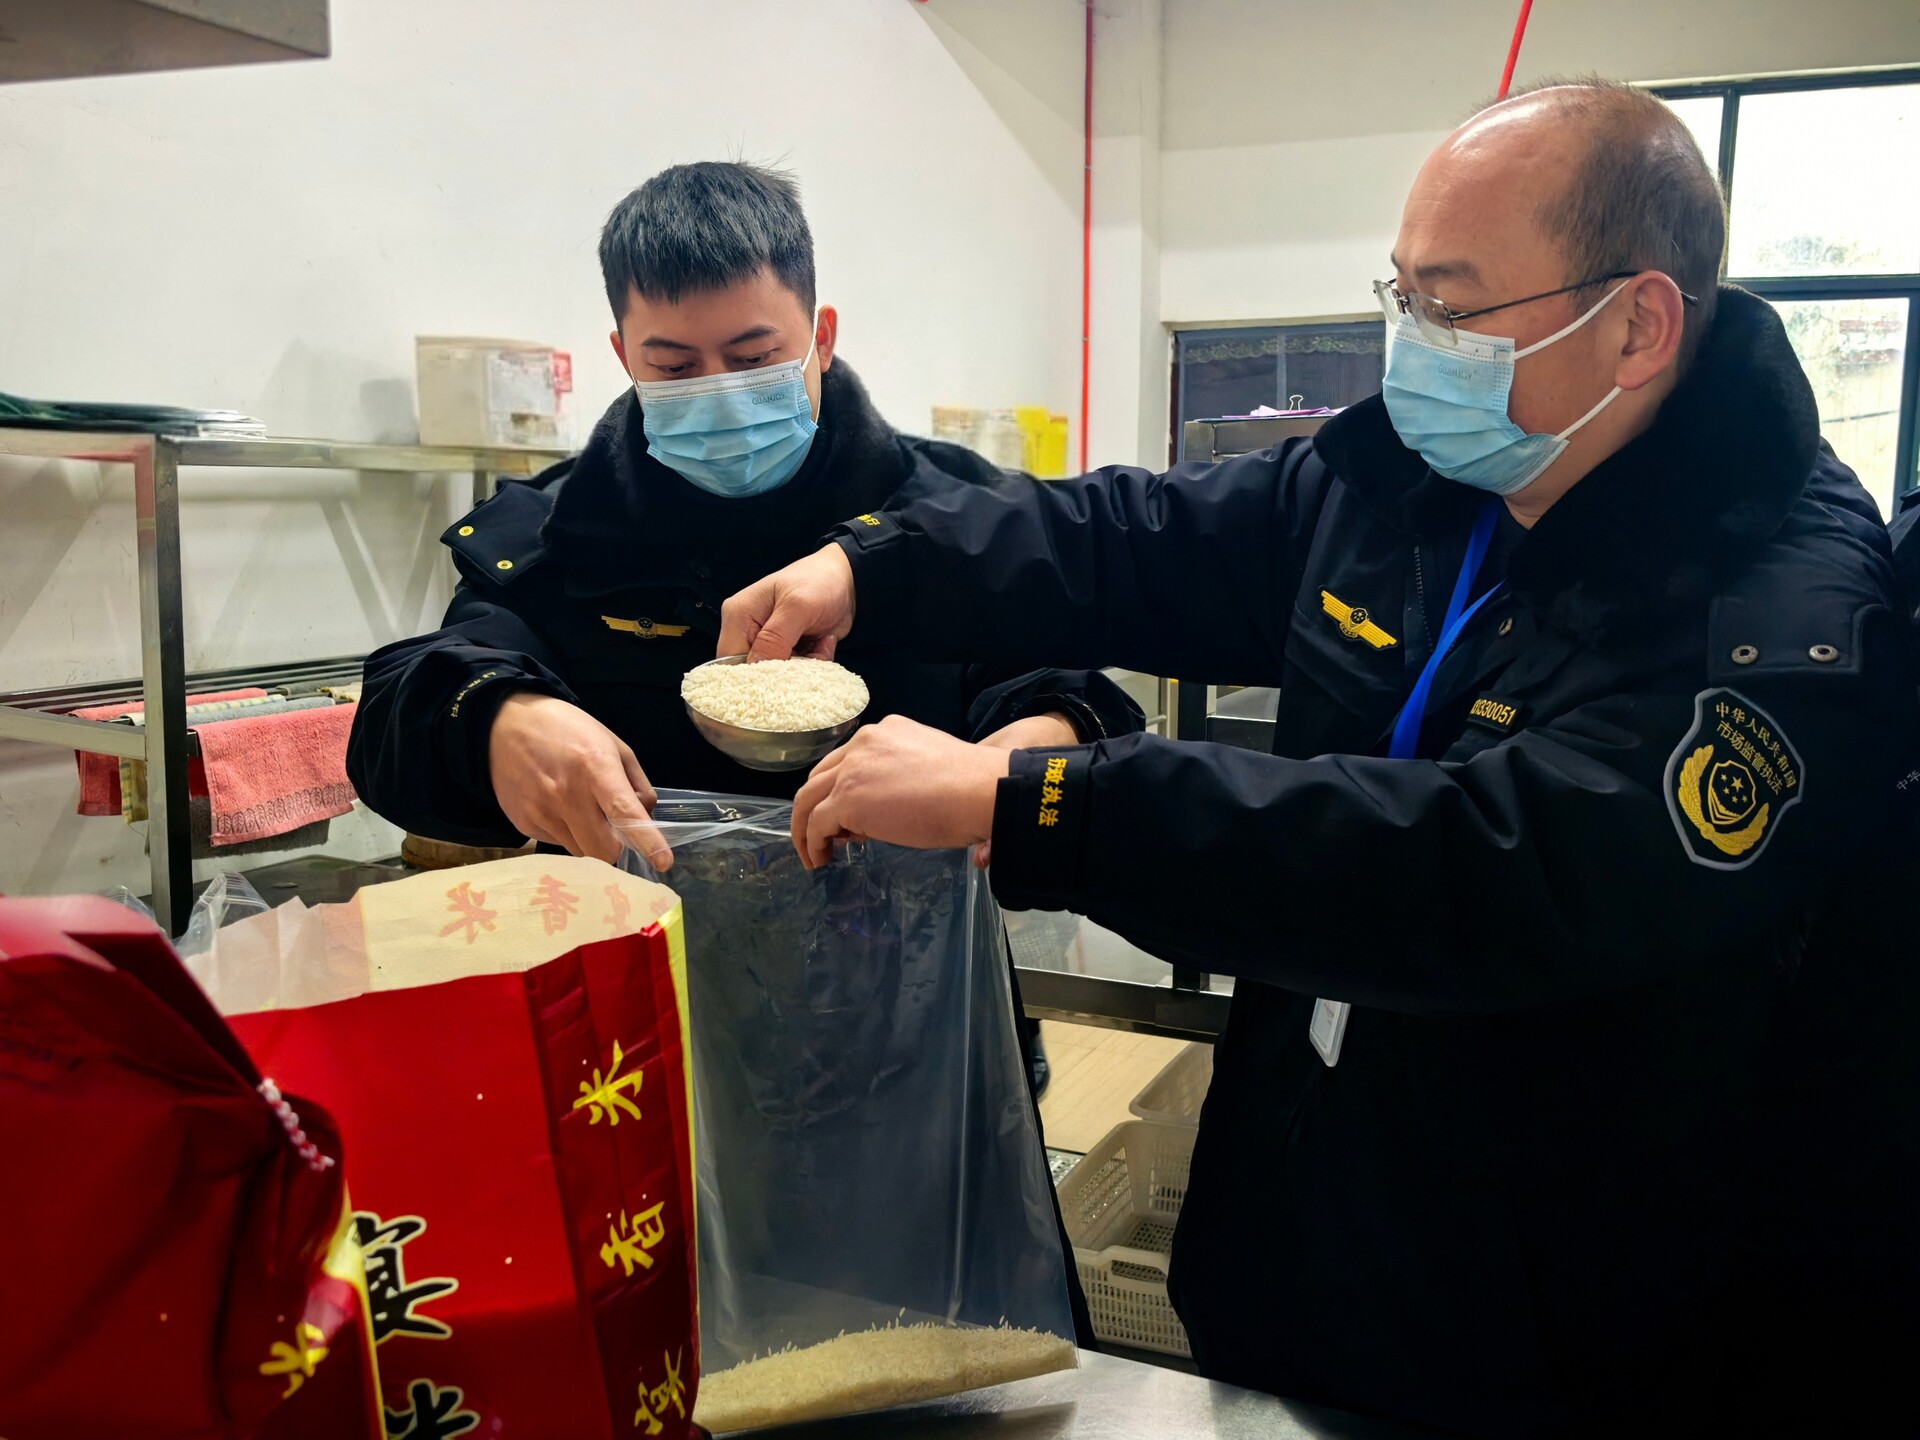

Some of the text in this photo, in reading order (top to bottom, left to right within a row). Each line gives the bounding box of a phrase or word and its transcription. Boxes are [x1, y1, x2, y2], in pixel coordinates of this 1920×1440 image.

[1716, 701, 1797, 788] 中华人民共和国
[1716, 720, 1785, 796] 市场监管执法
[1039, 757, 1068, 827] 行政执法
